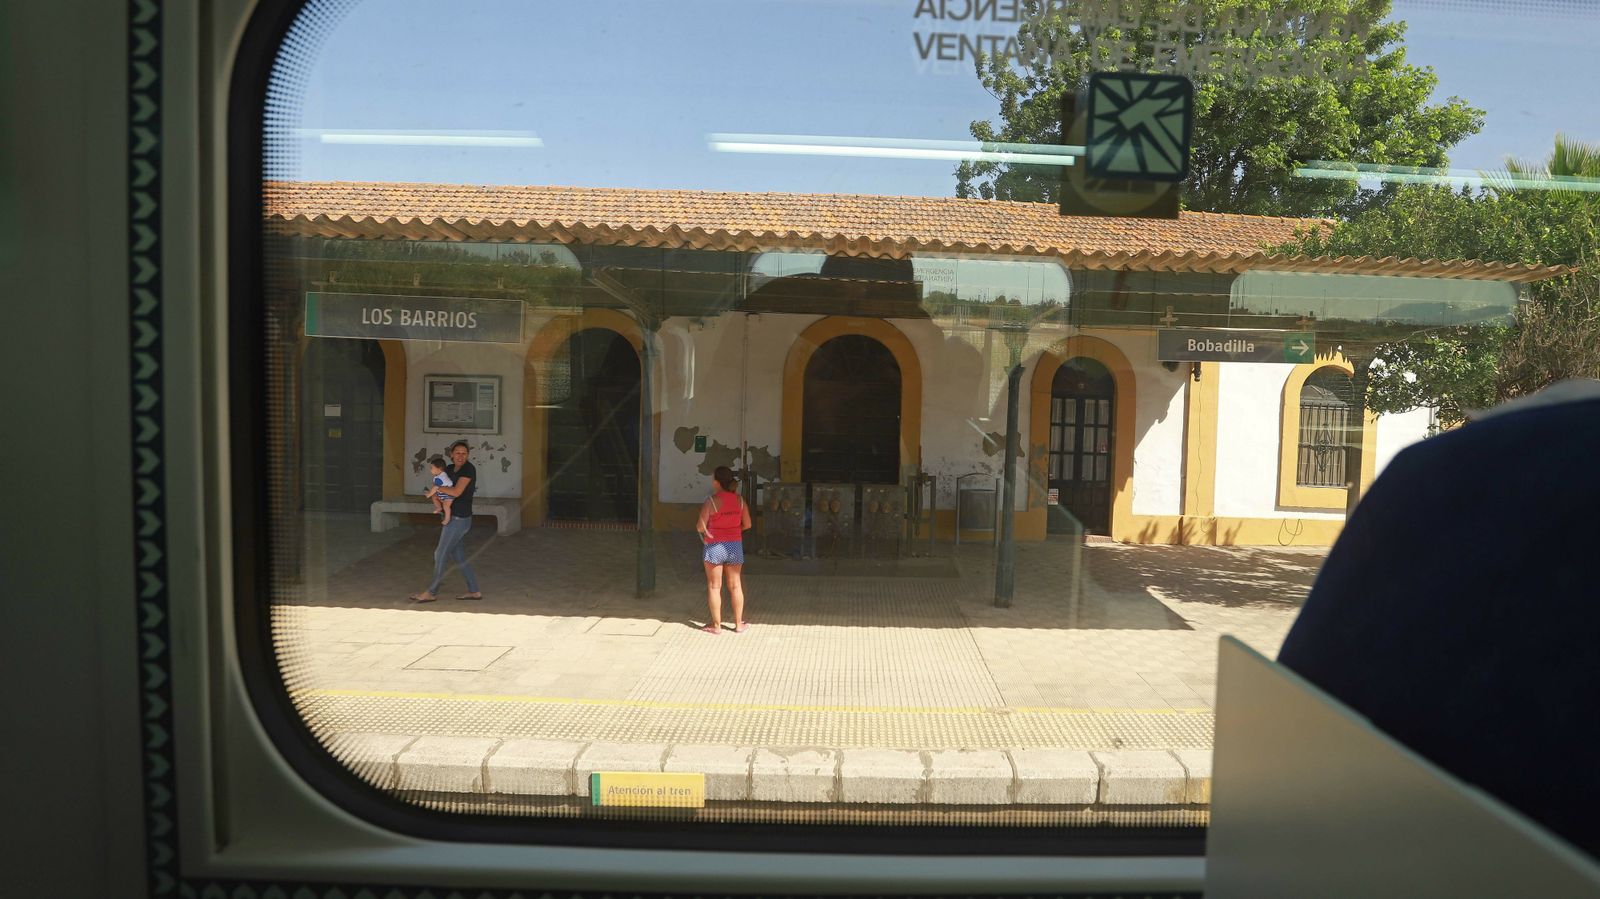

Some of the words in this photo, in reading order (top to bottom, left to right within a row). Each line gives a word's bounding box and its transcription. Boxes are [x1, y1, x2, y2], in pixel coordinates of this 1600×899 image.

[913, 31, 1071, 66] VENTANA
[361, 308, 393, 325] LOS
[400, 310, 478, 329] BARRIOS
[1187, 338, 1255, 353] Bobadilla
[608, 785, 653, 795] Atención
[657, 786, 666, 796] al
[670, 787, 691, 796] tren
